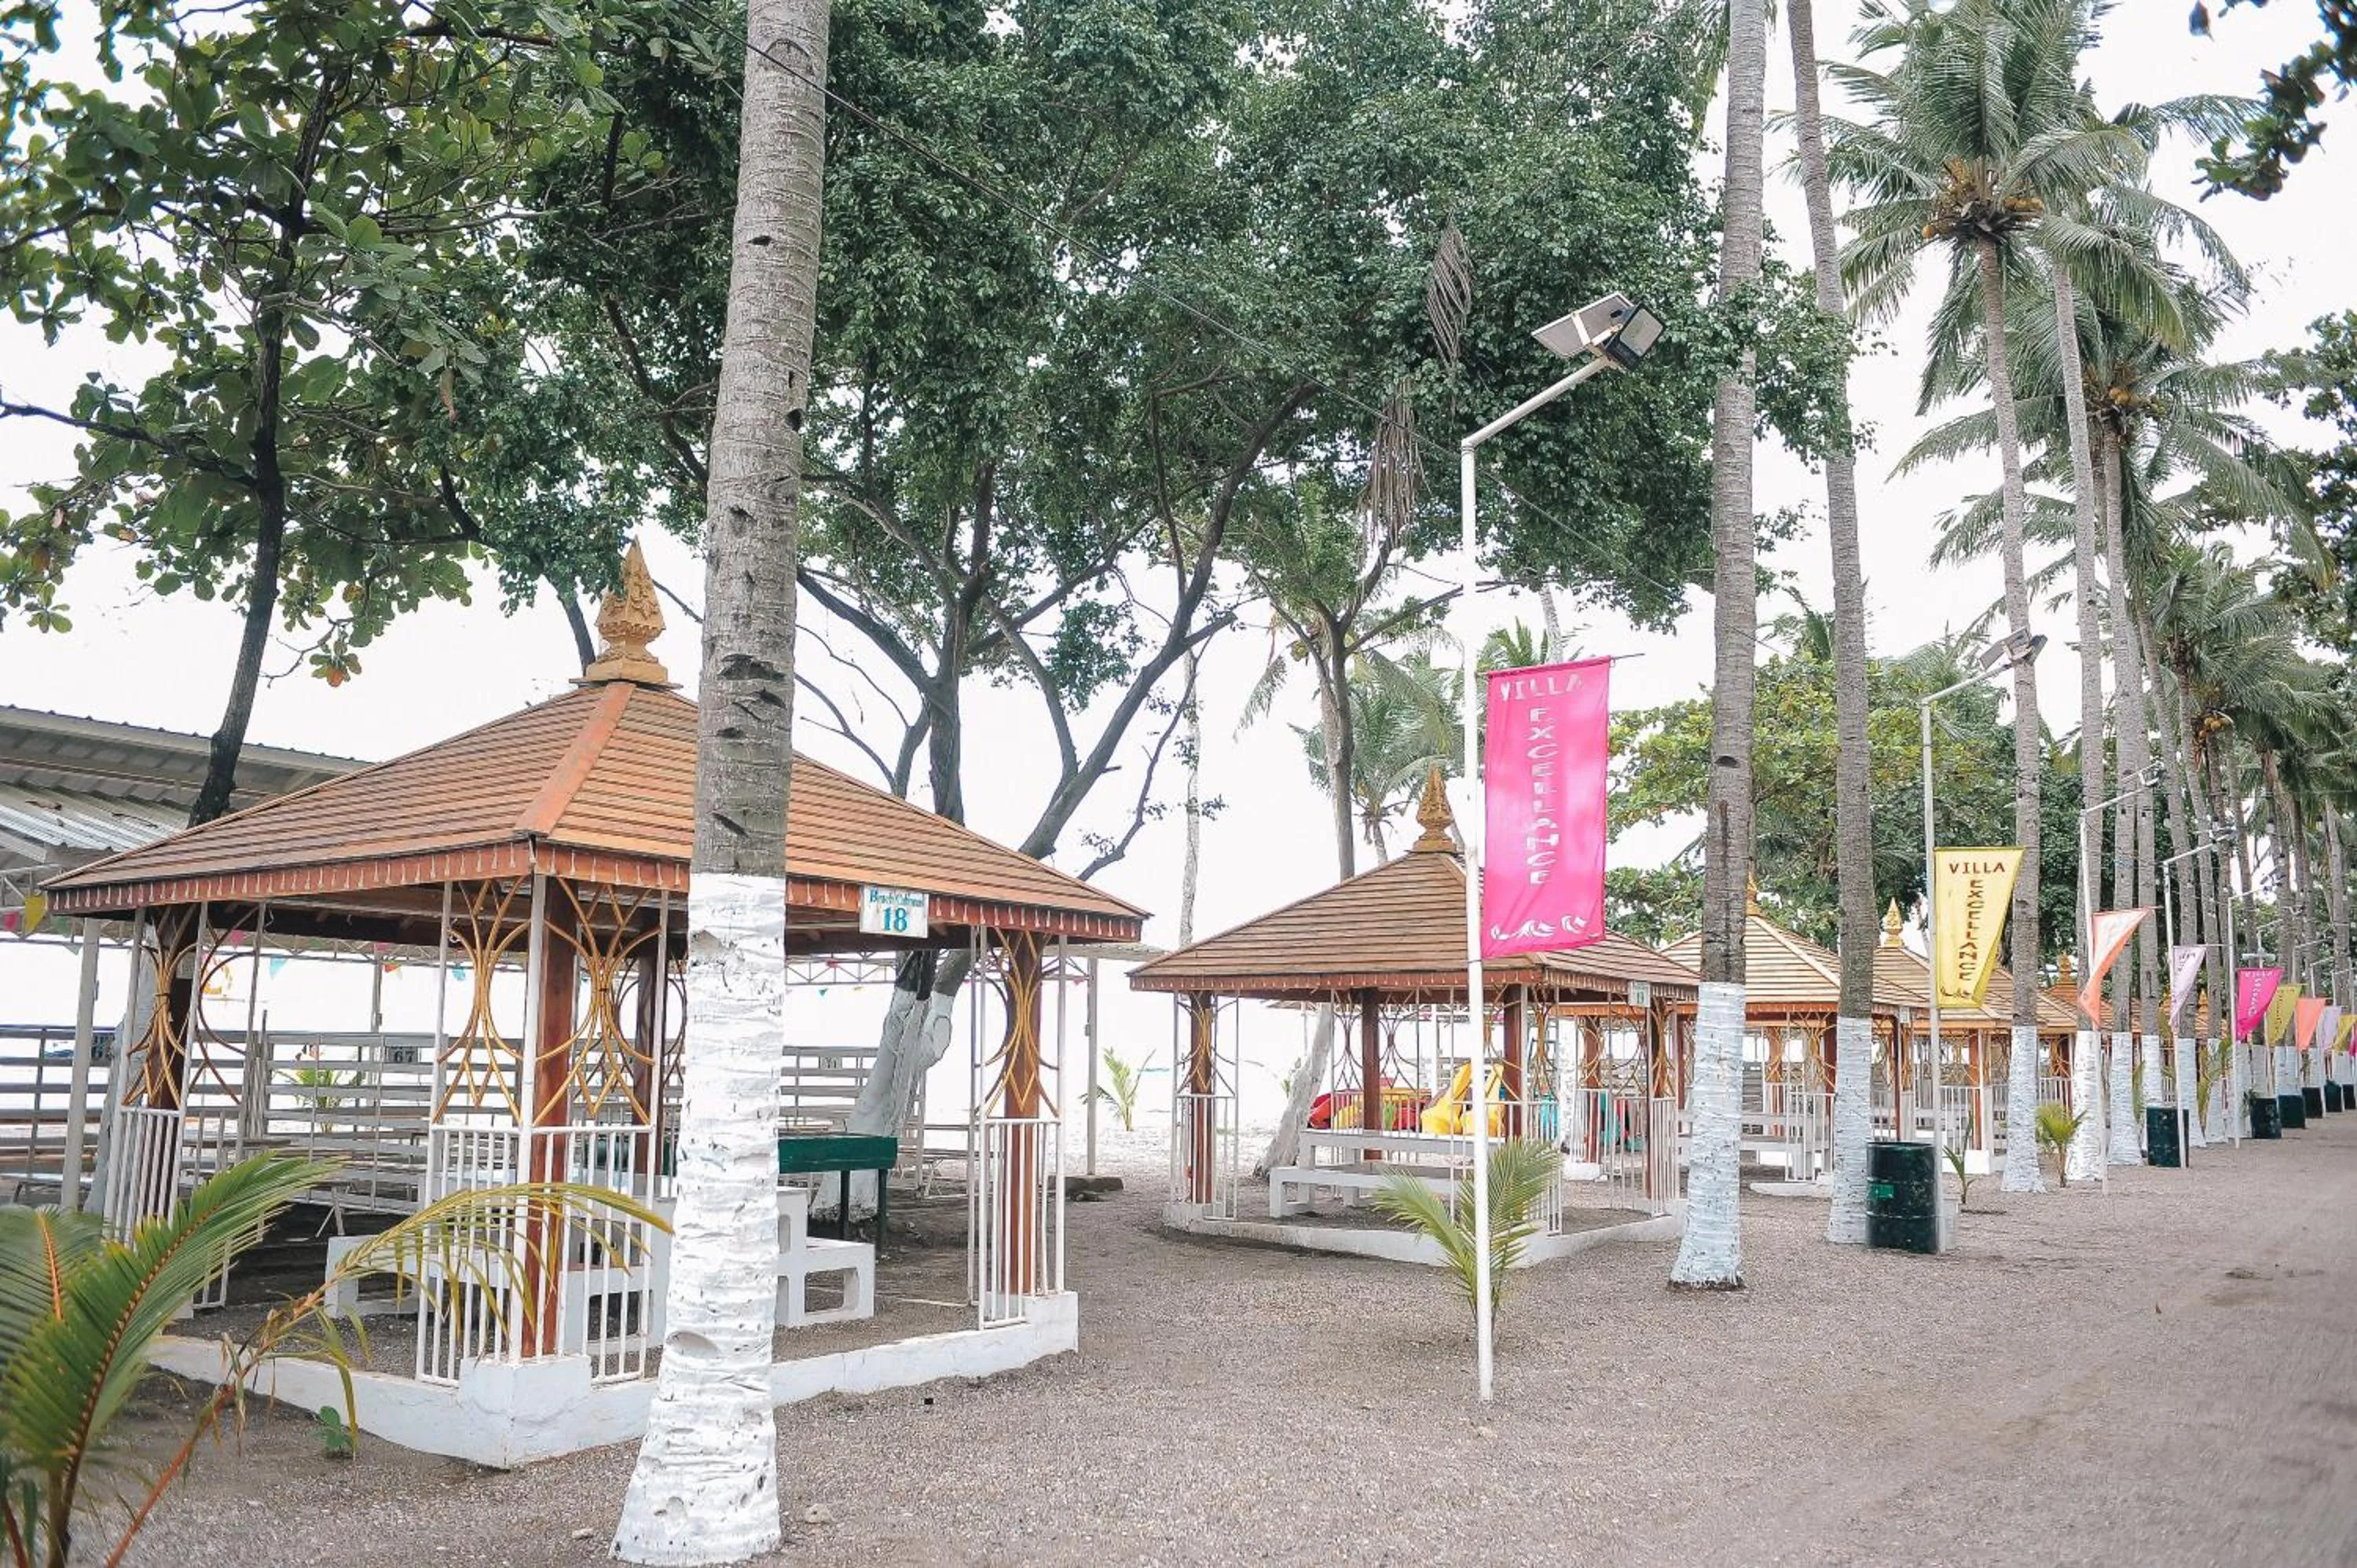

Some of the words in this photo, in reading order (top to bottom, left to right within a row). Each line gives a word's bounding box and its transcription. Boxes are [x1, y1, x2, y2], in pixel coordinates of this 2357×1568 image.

[1500, 673, 1583, 701] VILLA
[1949, 862, 2005, 874] VILLA
[883, 907, 907, 932] 18
[394, 1050, 415, 1064] 67
